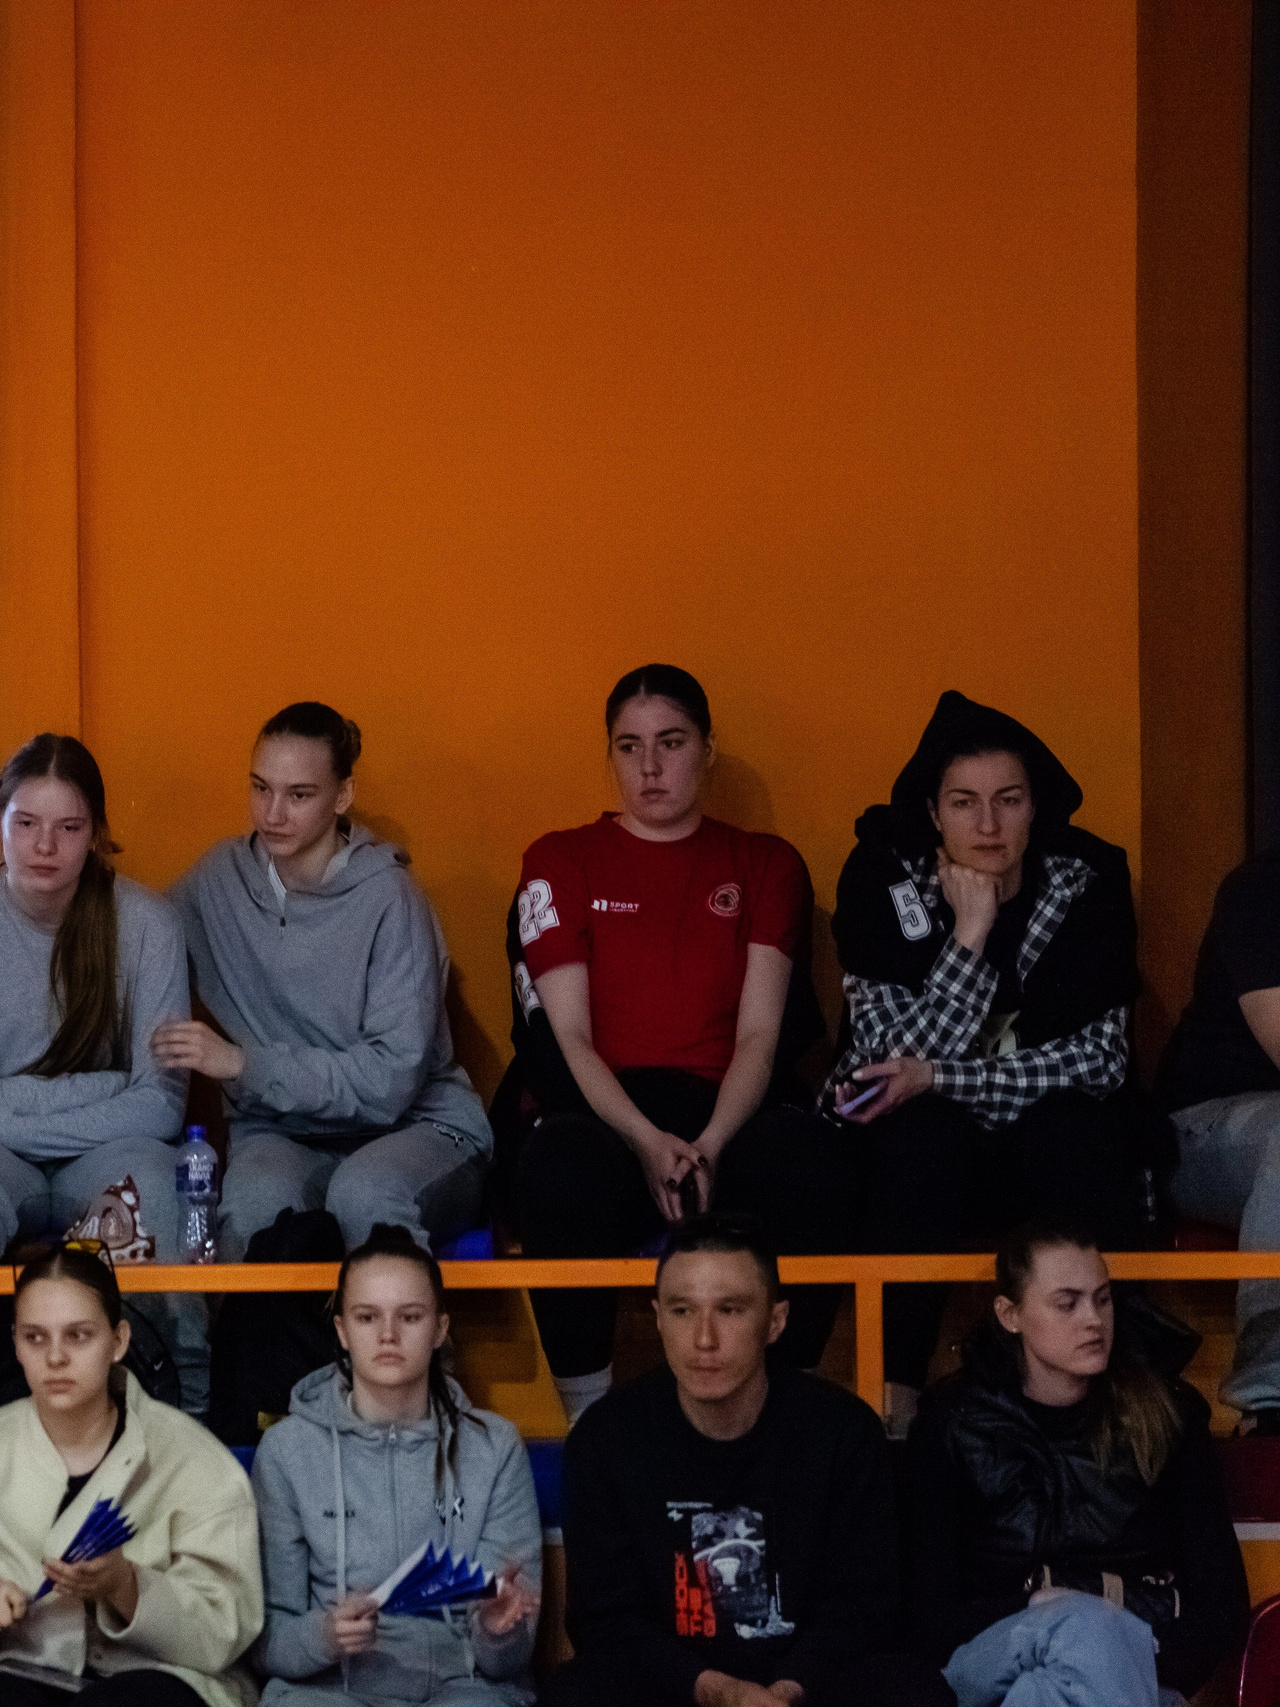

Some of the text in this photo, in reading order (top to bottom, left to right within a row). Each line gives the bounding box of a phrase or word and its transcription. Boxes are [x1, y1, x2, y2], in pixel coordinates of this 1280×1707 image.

[518, 879, 560, 947] 22
[610, 901, 639, 910] SPORT
[888, 879, 932, 941] 5
